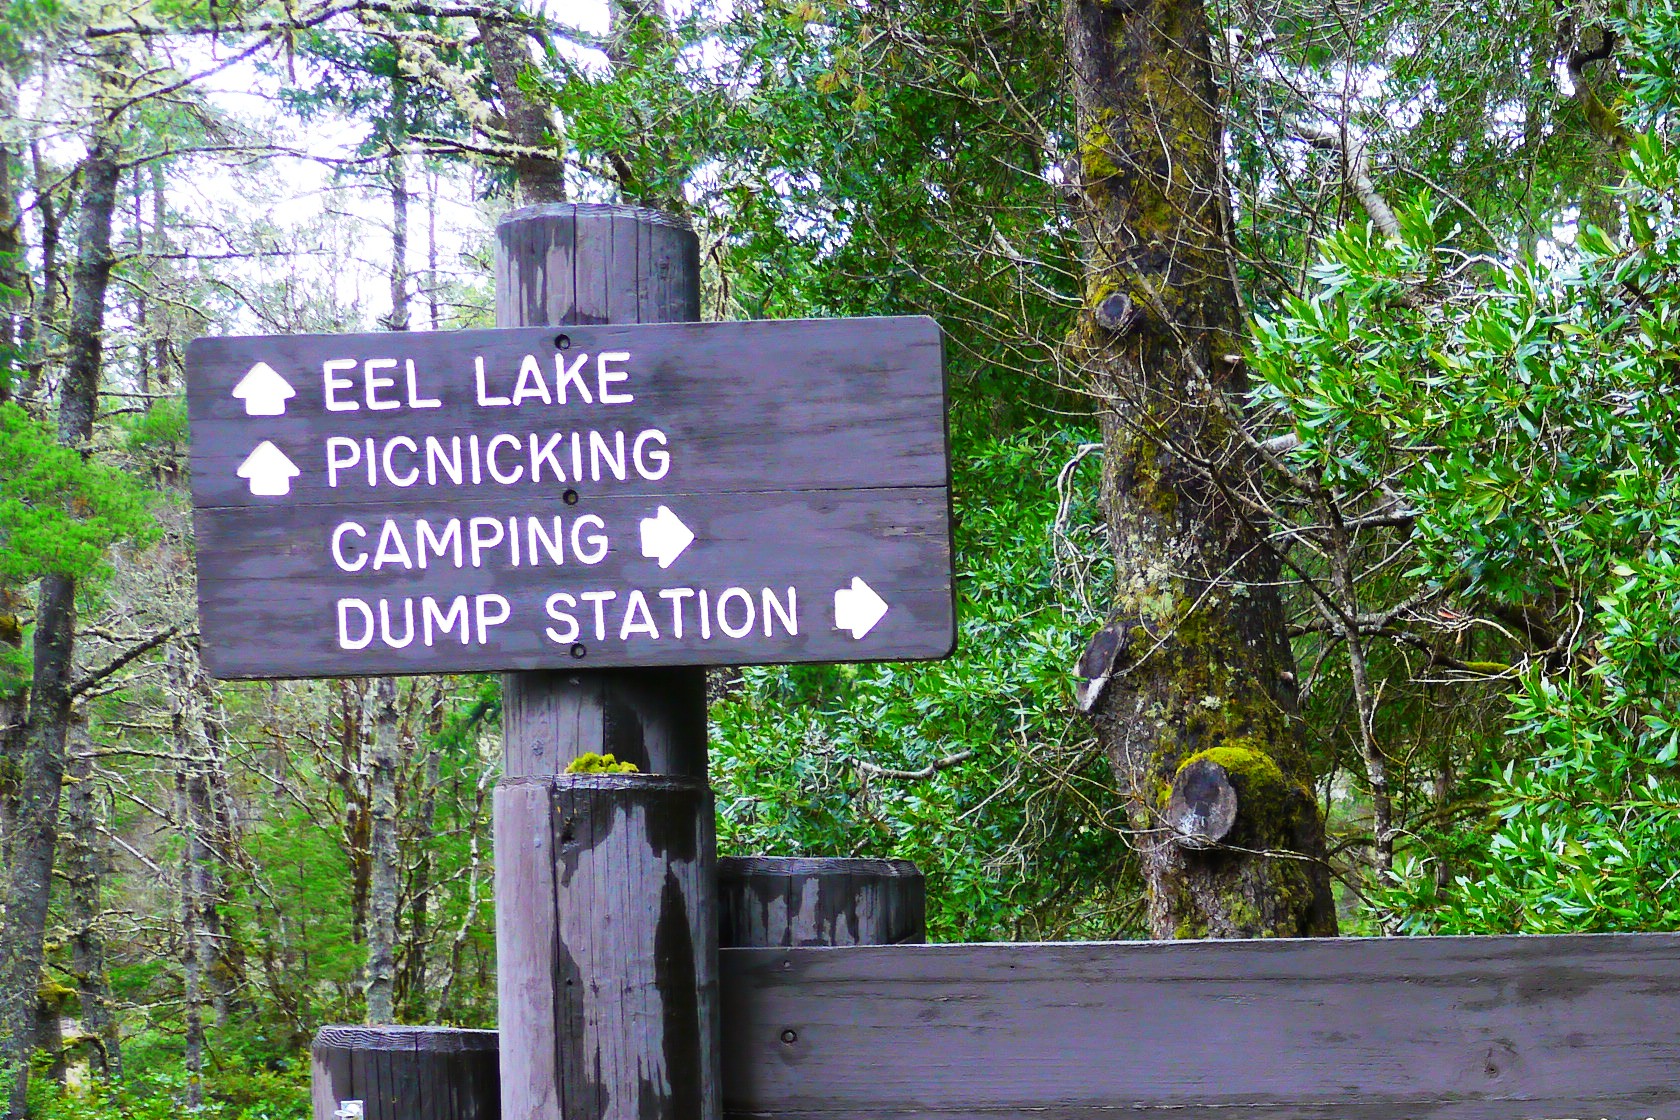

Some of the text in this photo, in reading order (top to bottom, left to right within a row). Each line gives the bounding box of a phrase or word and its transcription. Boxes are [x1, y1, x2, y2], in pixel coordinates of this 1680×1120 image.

[320, 350, 635, 413] EEL LAKE
[324, 427, 672, 489] PICNICKING
[330, 512, 610, 573] CAMPING
[336, 585, 799, 651] DUMP STATION
